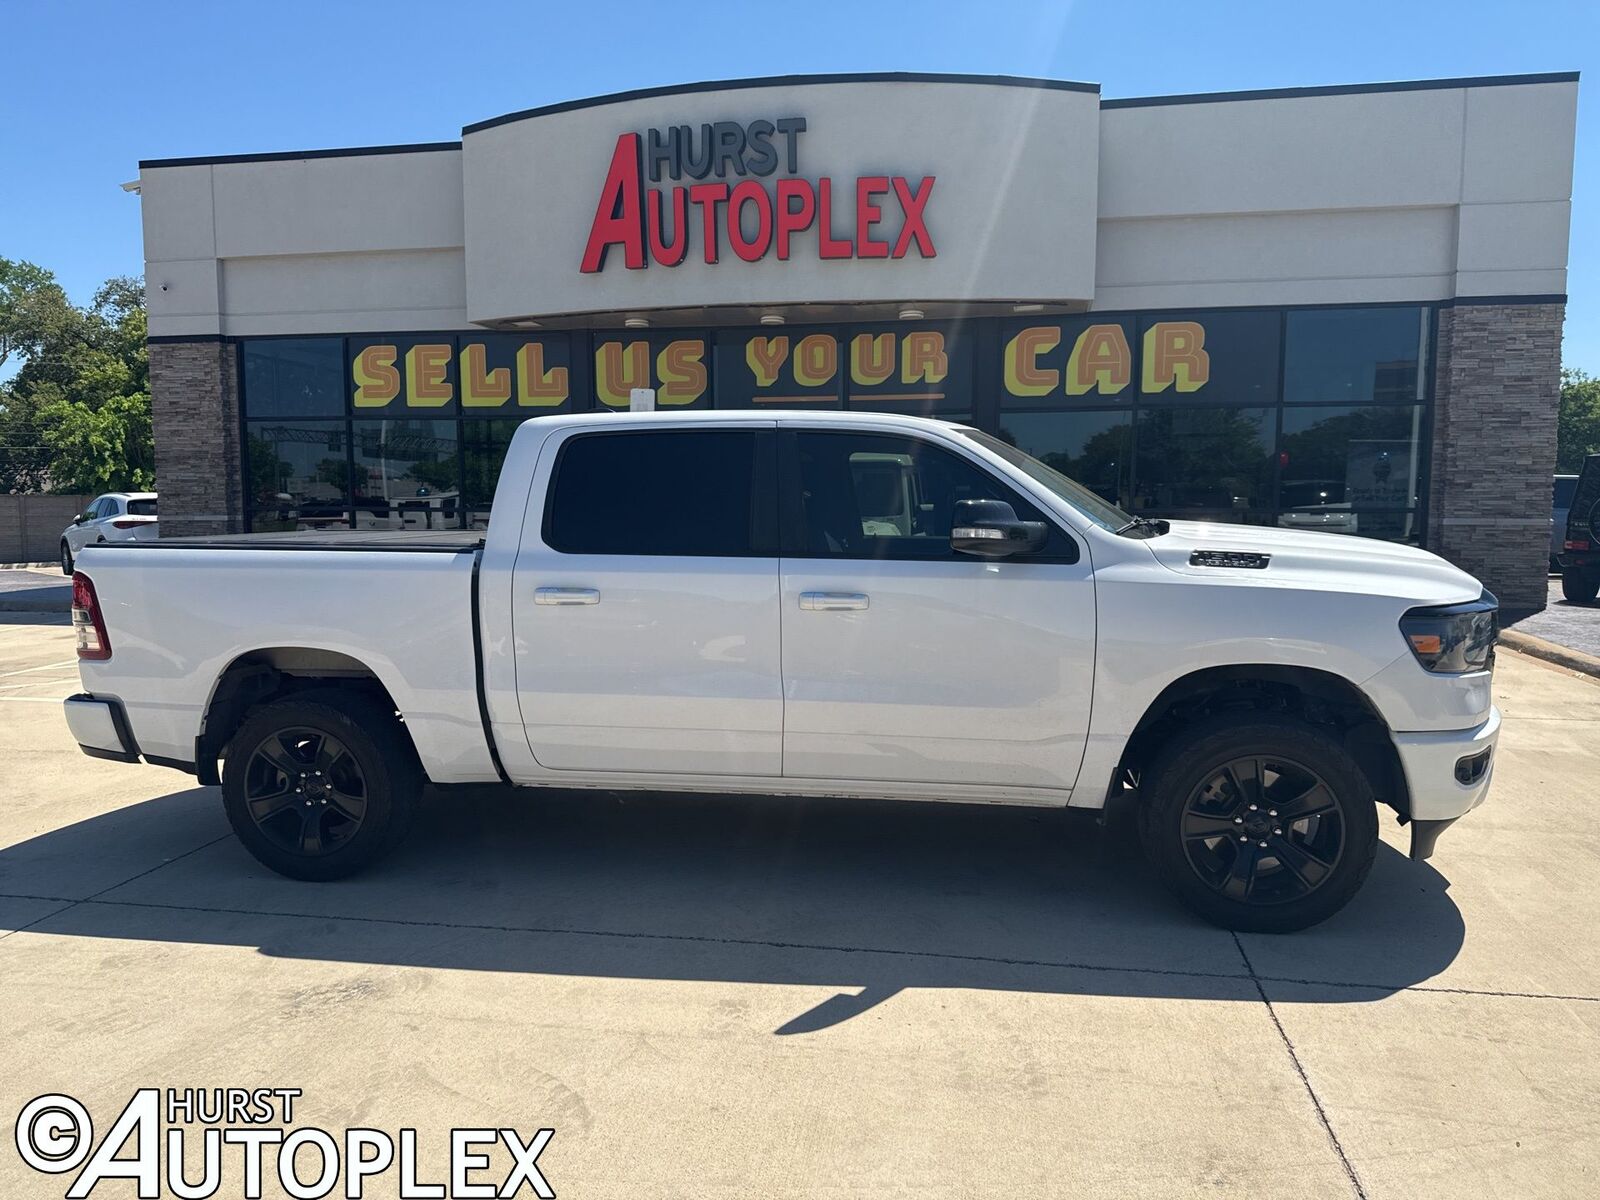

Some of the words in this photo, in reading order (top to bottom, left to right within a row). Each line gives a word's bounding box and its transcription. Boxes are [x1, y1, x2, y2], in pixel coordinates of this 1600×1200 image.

[648, 117, 807, 182] HURST
[580, 132, 937, 274] AUTOPLEX
[353, 343, 569, 407] SELL
[596, 340, 707, 406] US
[746, 331, 948, 387] YOUR
[1004, 321, 1209, 397] CAR
